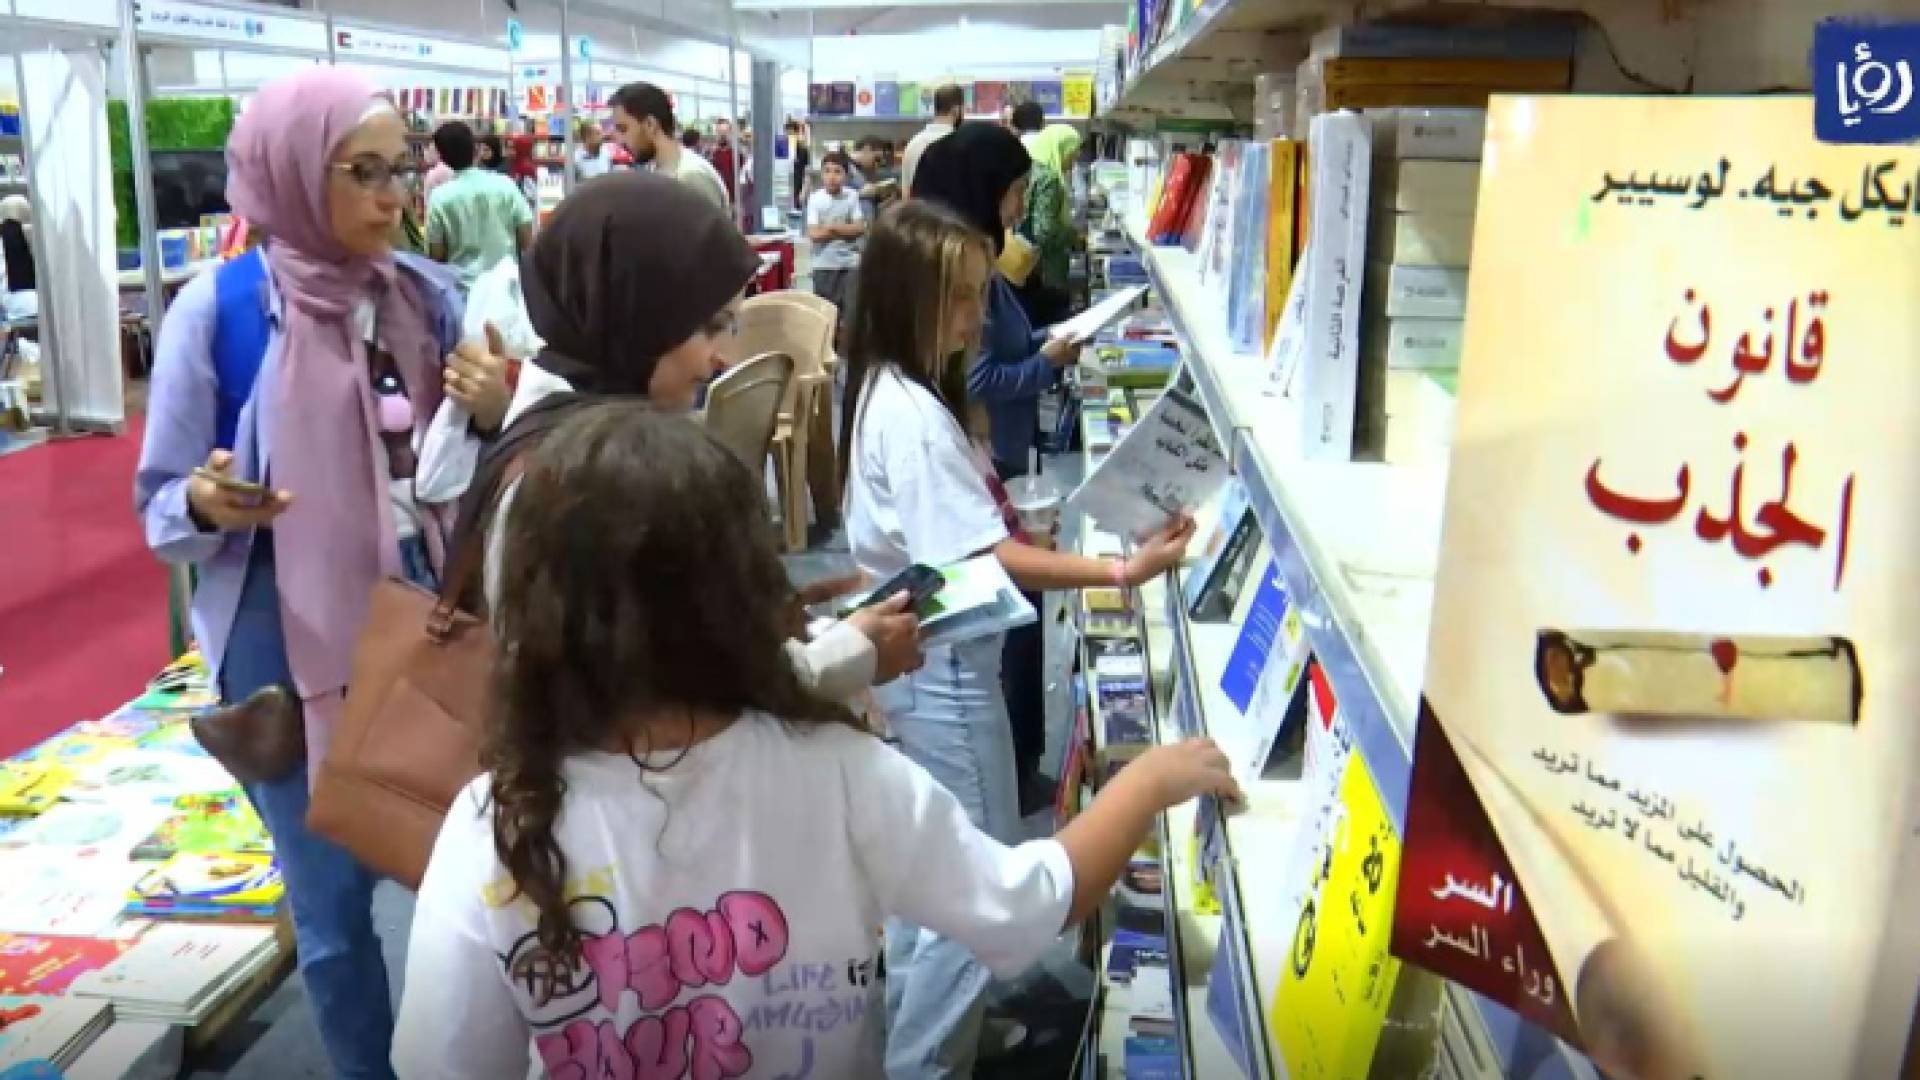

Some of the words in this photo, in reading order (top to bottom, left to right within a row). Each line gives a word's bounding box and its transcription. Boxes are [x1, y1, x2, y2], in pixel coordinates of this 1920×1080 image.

[1591, 155, 1731, 208] لوسيير
[1838, 158, 1920, 227] ايكل
[1664, 288, 1829, 403] قانون
[1584, 430, 1855, 592] الجذب
[1531, 746, 1579, 774] تريد
[1585, 759, 1621, 791] مما
[1570, 800, 1617, 829] تريد
[1626, 789, 1676, 820] المزيد
[1622, 816, 1641, 840] لا
[1644, 827, 1676, 863] مما
[1677, 818, 1713, 848] على
[1677, 855, 1746, 921] والقليل
[1717, 838, 1805, 905] الحصول
[1429, 872, 1513, 915] السر
[1423, 922, 1489, 960] السر
[1501, 942, 1555, 1004] وراء
